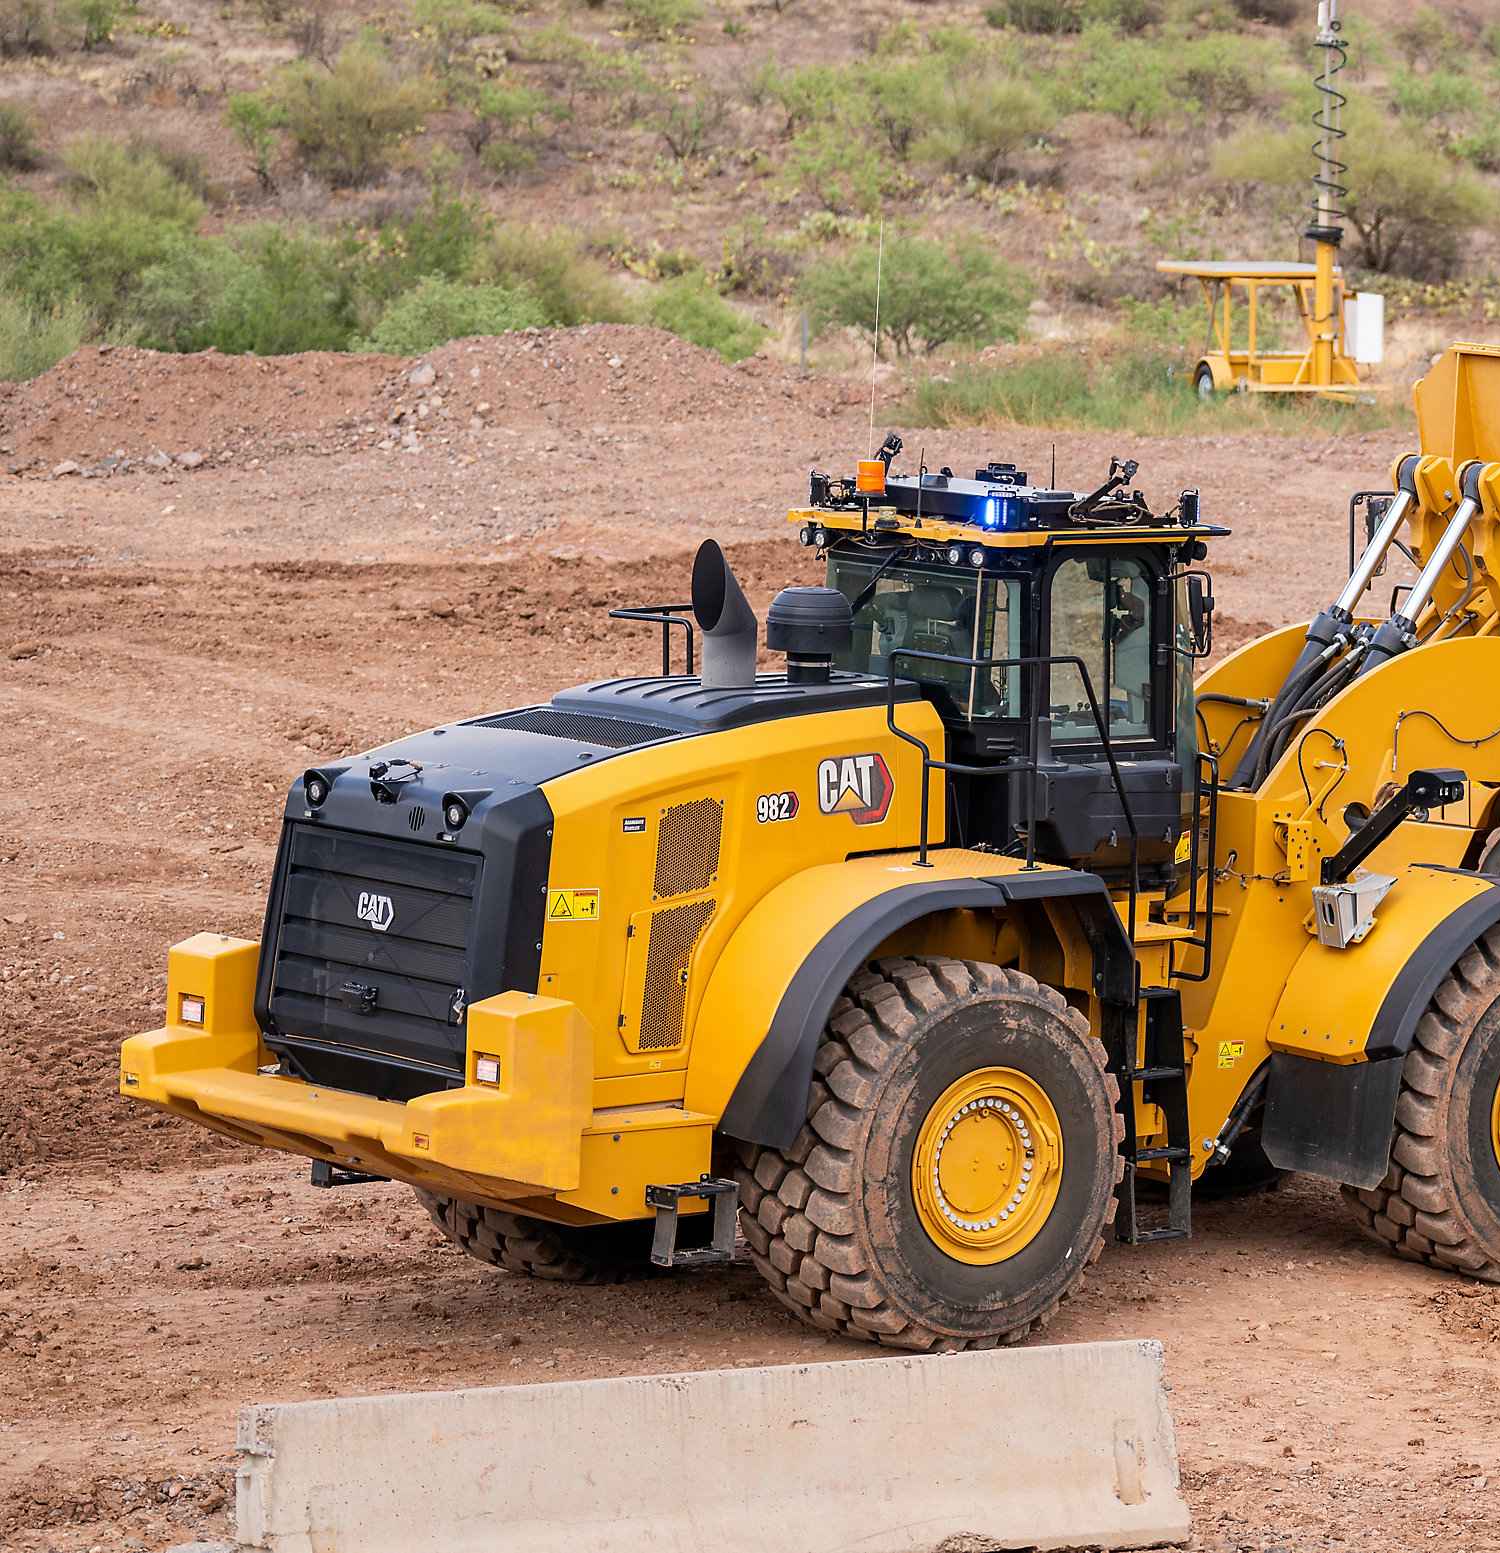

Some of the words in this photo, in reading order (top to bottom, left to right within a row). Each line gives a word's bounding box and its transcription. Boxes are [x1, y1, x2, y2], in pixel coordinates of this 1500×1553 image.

[819, 755, 874, 812] CAT
[757, 793, 790, 822] 982
[357, 891, 388, 923] CAT
